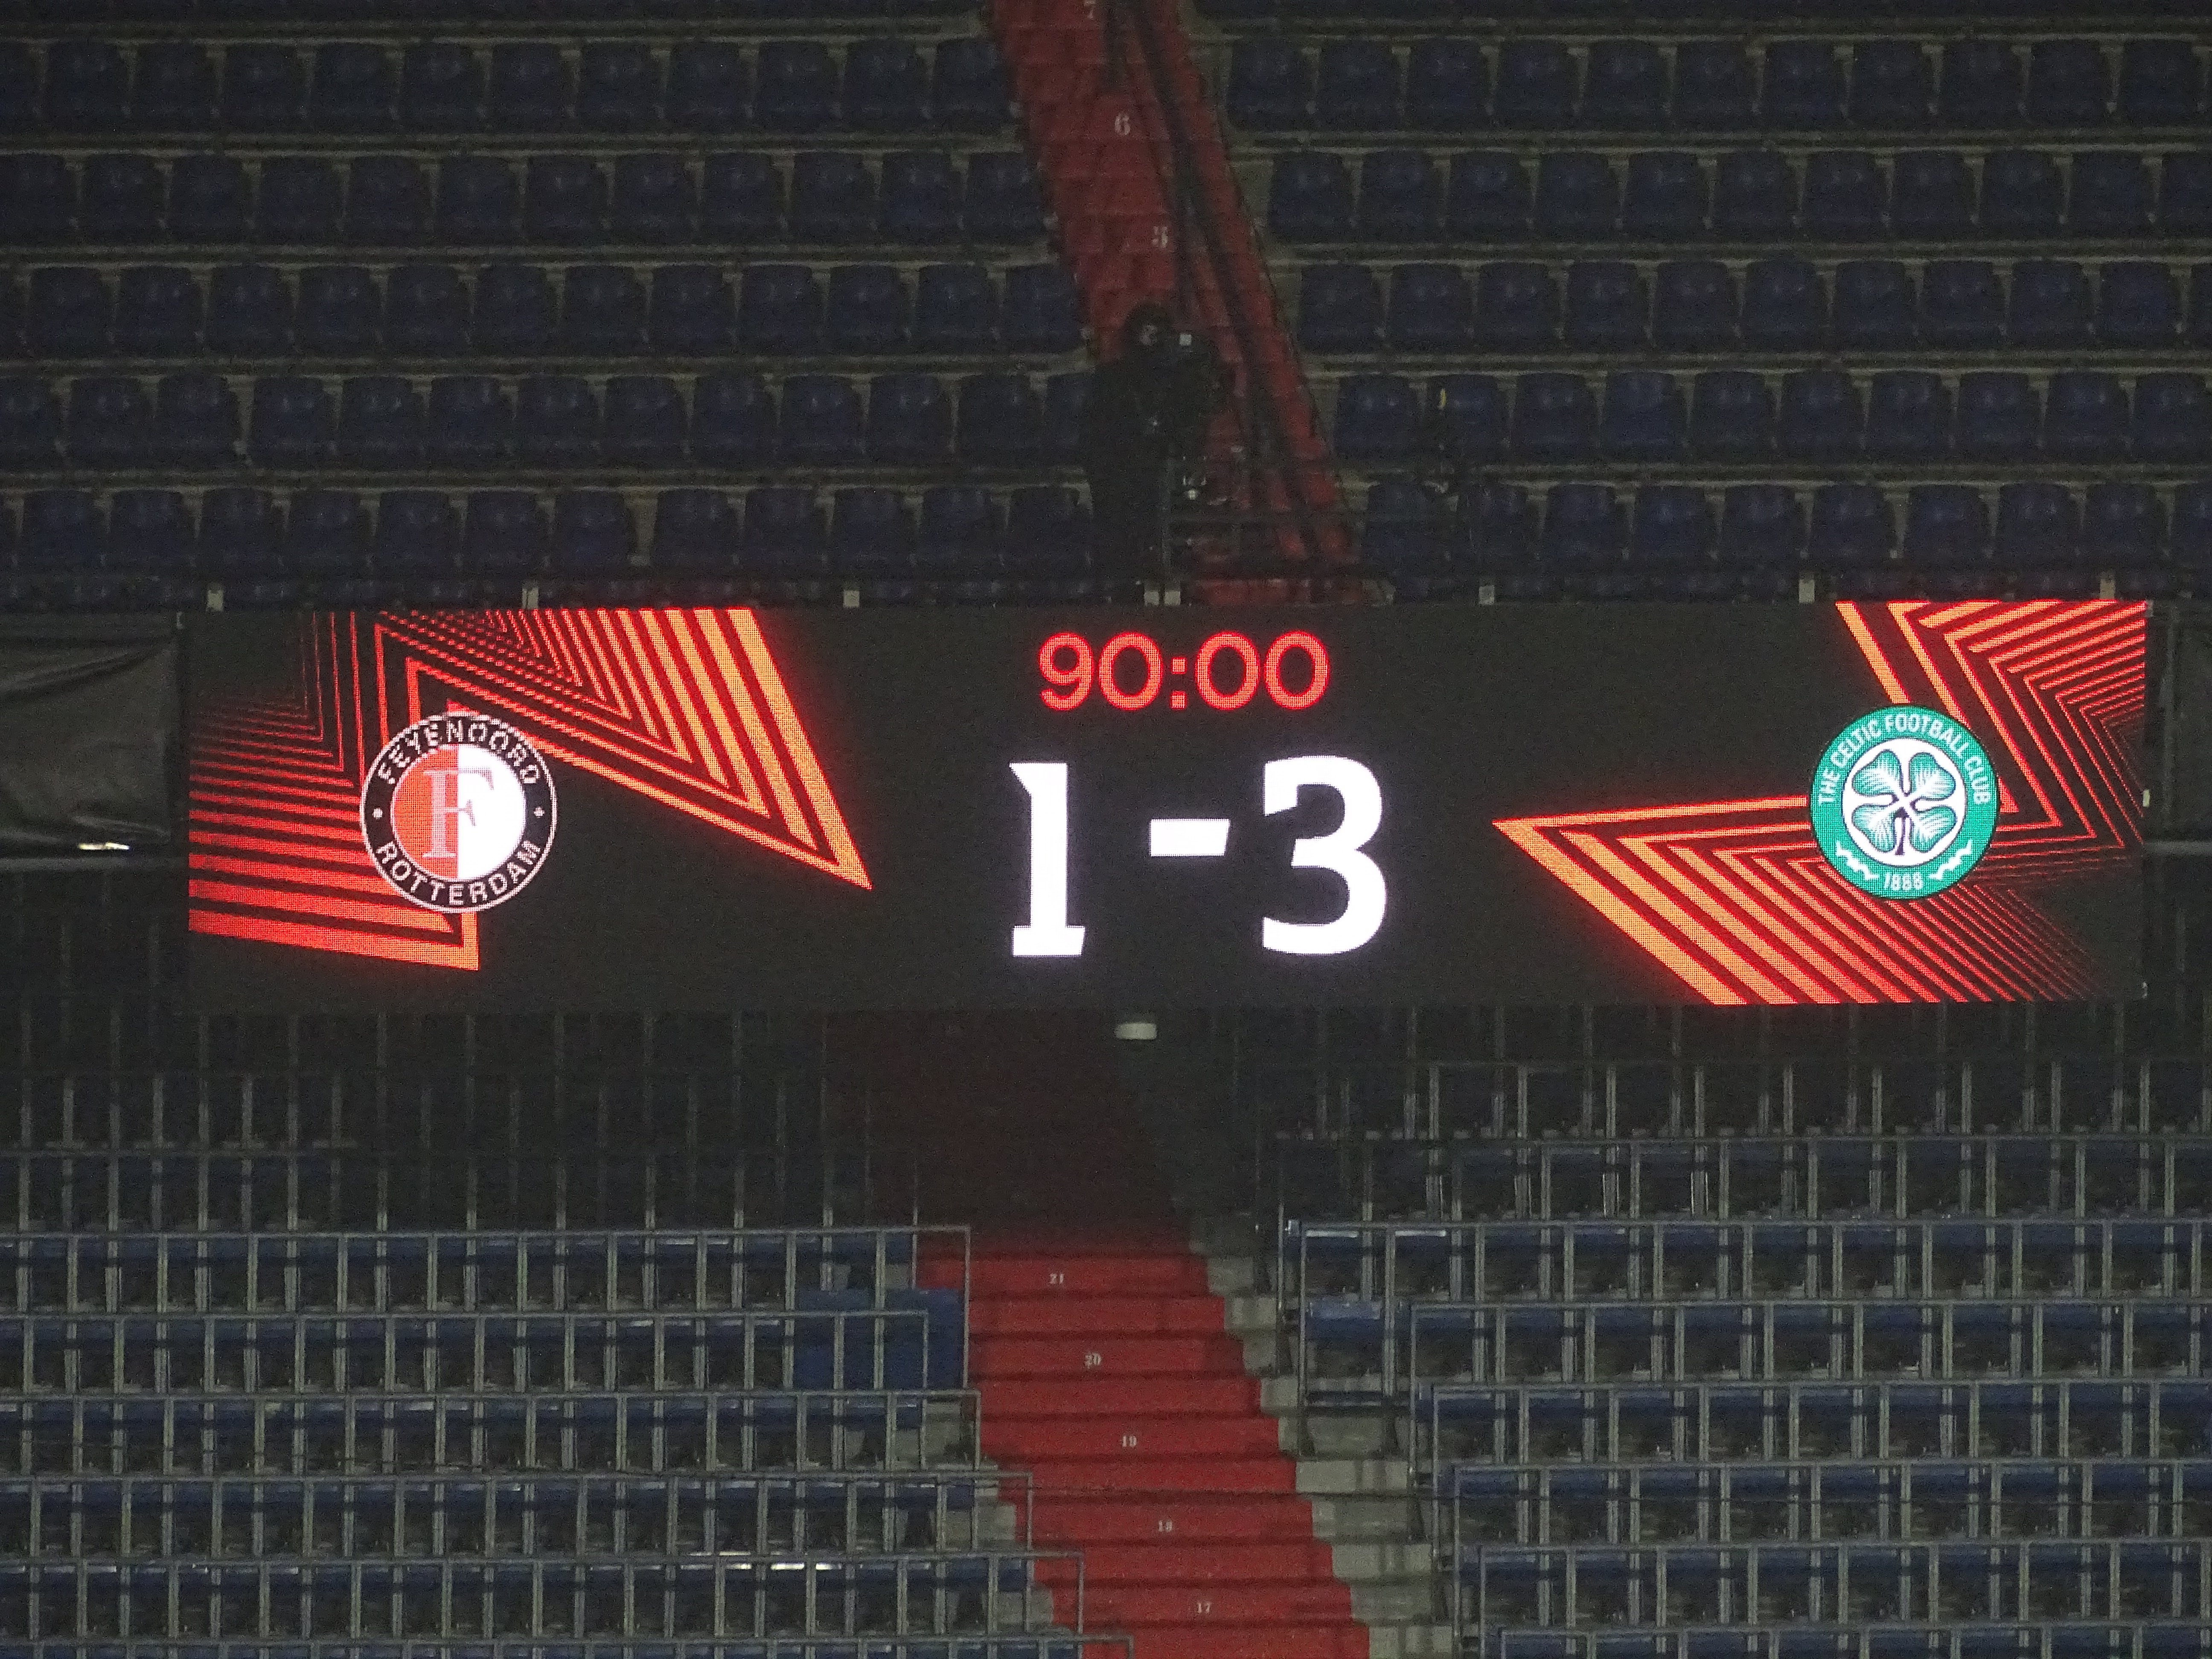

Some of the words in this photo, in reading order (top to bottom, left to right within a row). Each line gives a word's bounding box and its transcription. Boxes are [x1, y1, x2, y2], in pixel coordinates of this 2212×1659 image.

[1115, 112, 1131, 136] 6
[1038, 630, 1330, 710] 90:00
[378, 719, 540, 785] FEYENOORD
[1818, 768, 1840, 805] THE
[1830, 719, 1882, 768] CELTIC
[1885, 713, 1969, 760] FOOTBALL
[1964, 755, 1992, 804] CLUB
[422, 765, 495, 859] F
[376, 840, 541, 905] ROTTERDAM
[1009, 763, 1086, 957] 1
[1150, 818, 1231, 857] -
[1262, 755, 1387, 955] 3
[1883, 872, 1925, 891] 1888
[1049, 1272, 1064, 1285] 21
[1084, 1352, 1102, 1368] 20
[1196, 1601, 1212, 1614] 17
